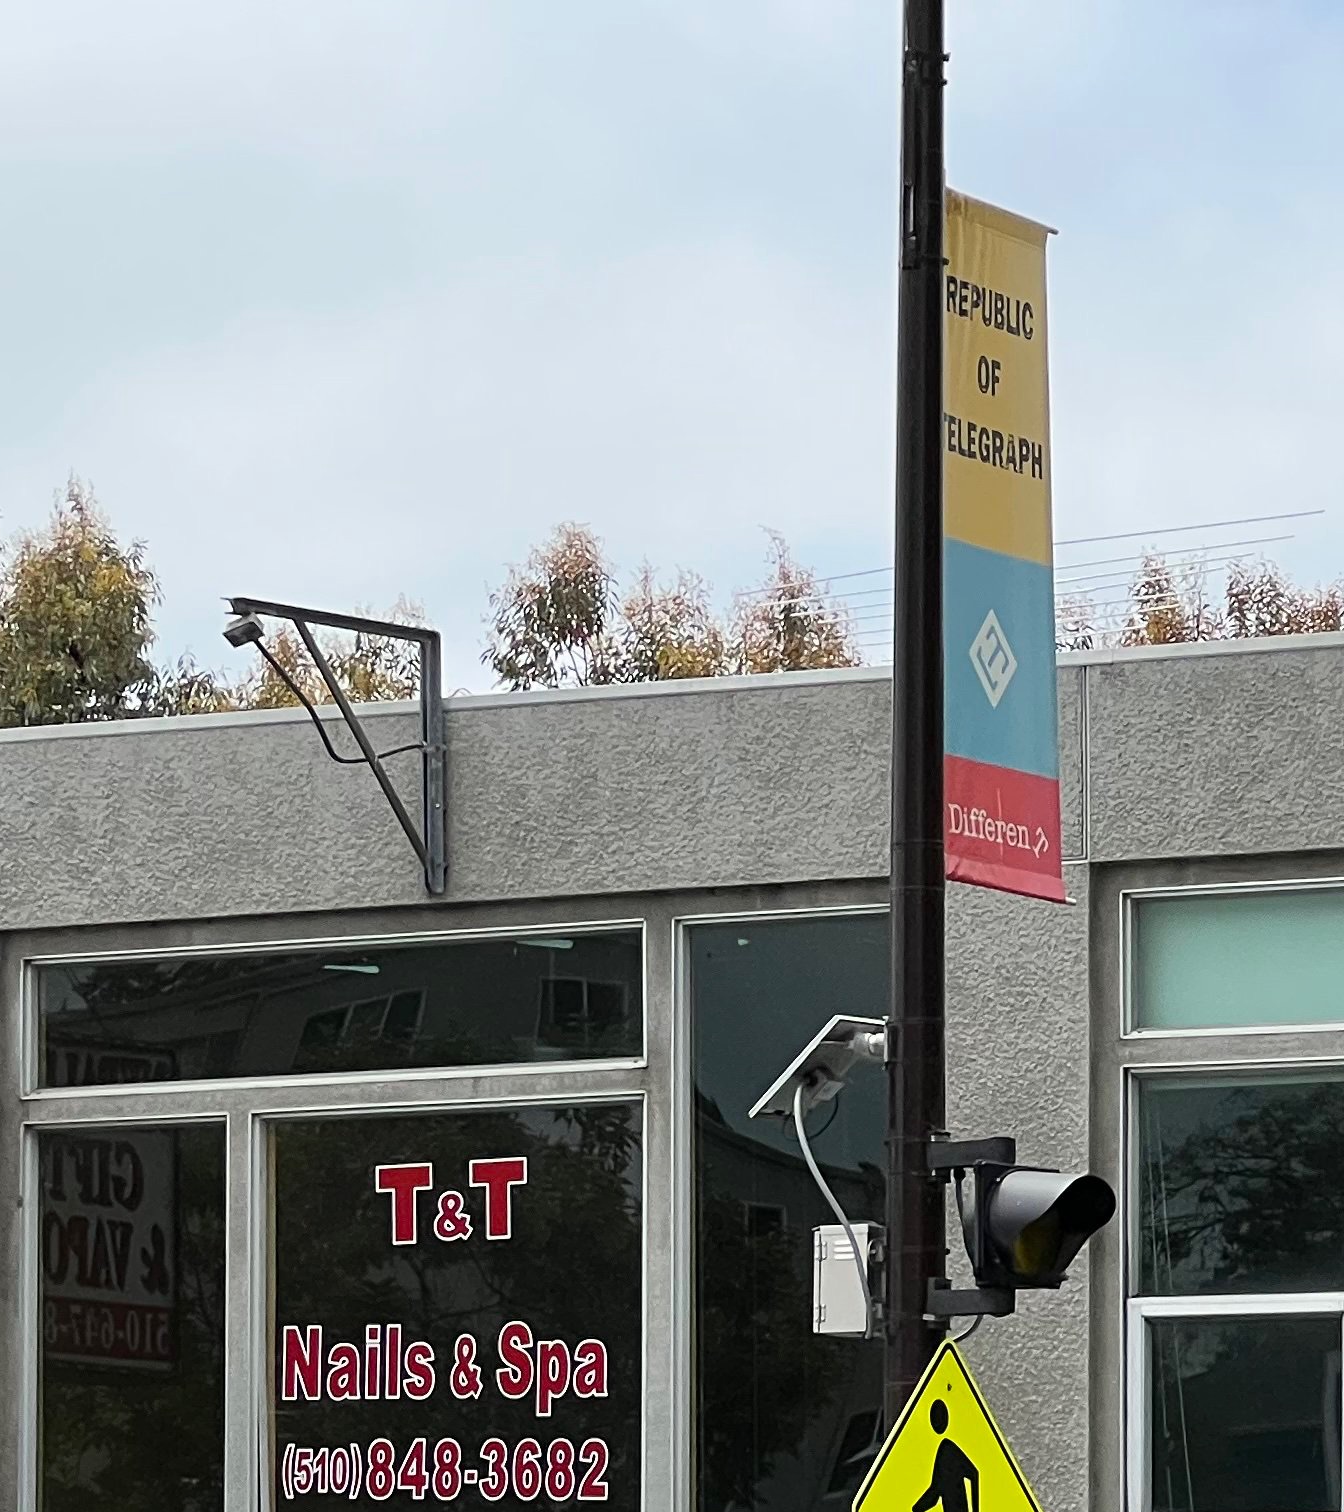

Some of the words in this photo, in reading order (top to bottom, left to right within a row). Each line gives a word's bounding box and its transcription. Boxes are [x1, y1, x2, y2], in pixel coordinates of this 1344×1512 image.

[946, 275, 1034, 340] REPUBLIC
[977, 355, 1001, 396] OF
[943, 412, 1043, 480] ELEGRAPH
[282, 1324, 435, 1401] Nails
[450, 1333, 483, 1400] &
[496, 1321, 609, 1418] Spa
